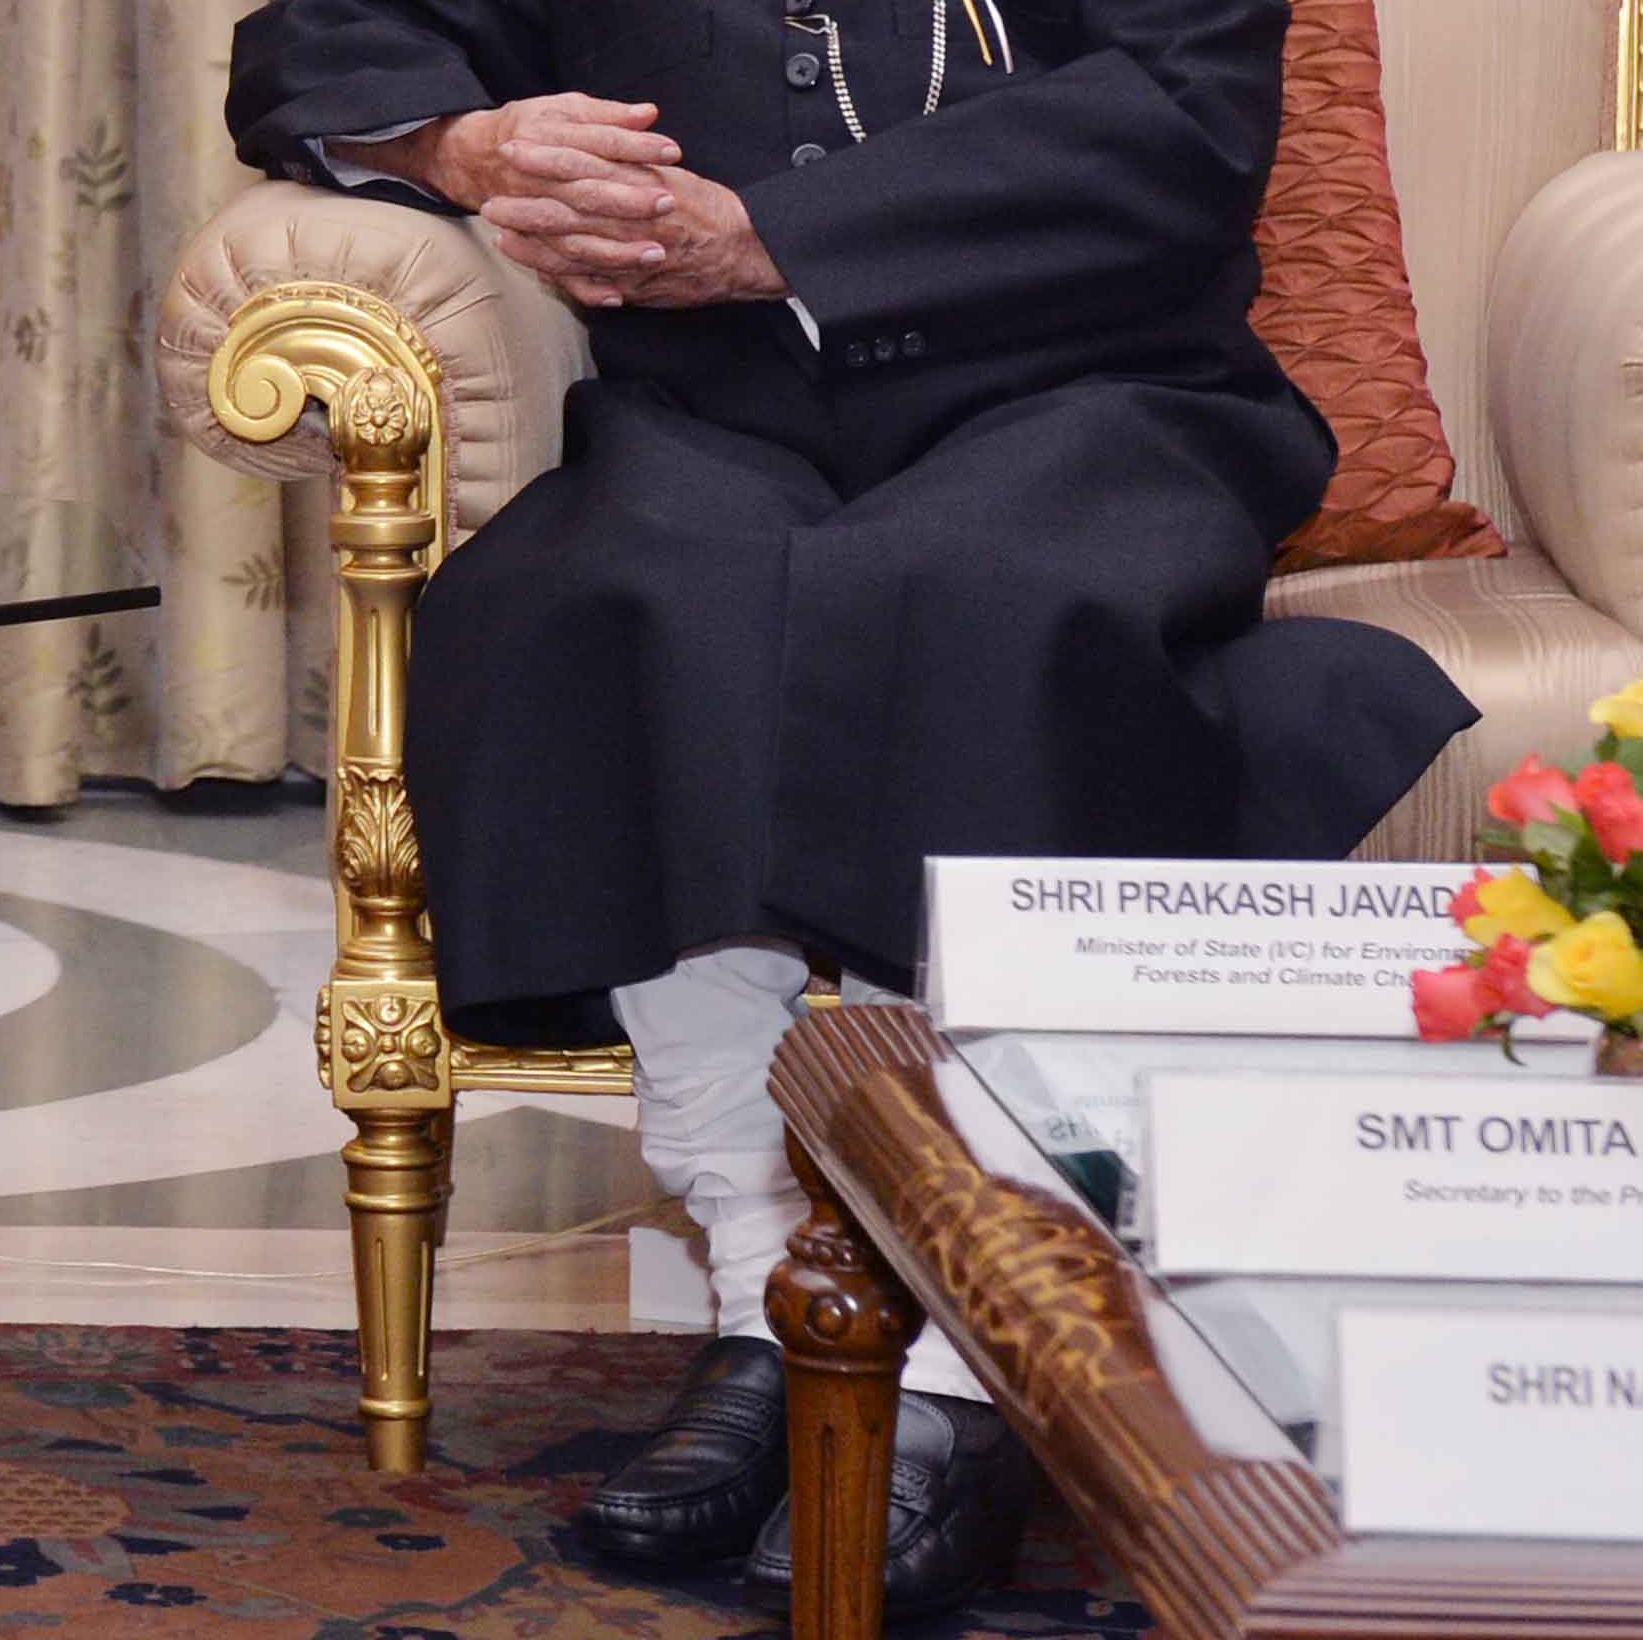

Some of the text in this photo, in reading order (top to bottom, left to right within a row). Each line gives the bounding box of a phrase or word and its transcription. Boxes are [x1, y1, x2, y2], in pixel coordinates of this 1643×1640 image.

[1012, 878, 1104, 912] SHRI
[1119, 881, 1314, 917] PRAKASH
[1075, 937, 1166, 956] Minister
[1174, 939, 1198, 956] of
[1204, 939, 1261, 958] State
[1321, 941, 1355, 959] for
[1133, 965, 1221, 984] Forests
[1227, 968, 1272, 984] and
[1278, 968, 1366, 986] Climate
[1358, 1113, 1637, 1157] SMT OMITA
[1404, 1180, 1528, 1207] Secretary
[1536, 1186, 1563, 1204] to
[1571, 1186, 1611, 1205] the
[1488, 1363, 1643, 1408] SHRI N
